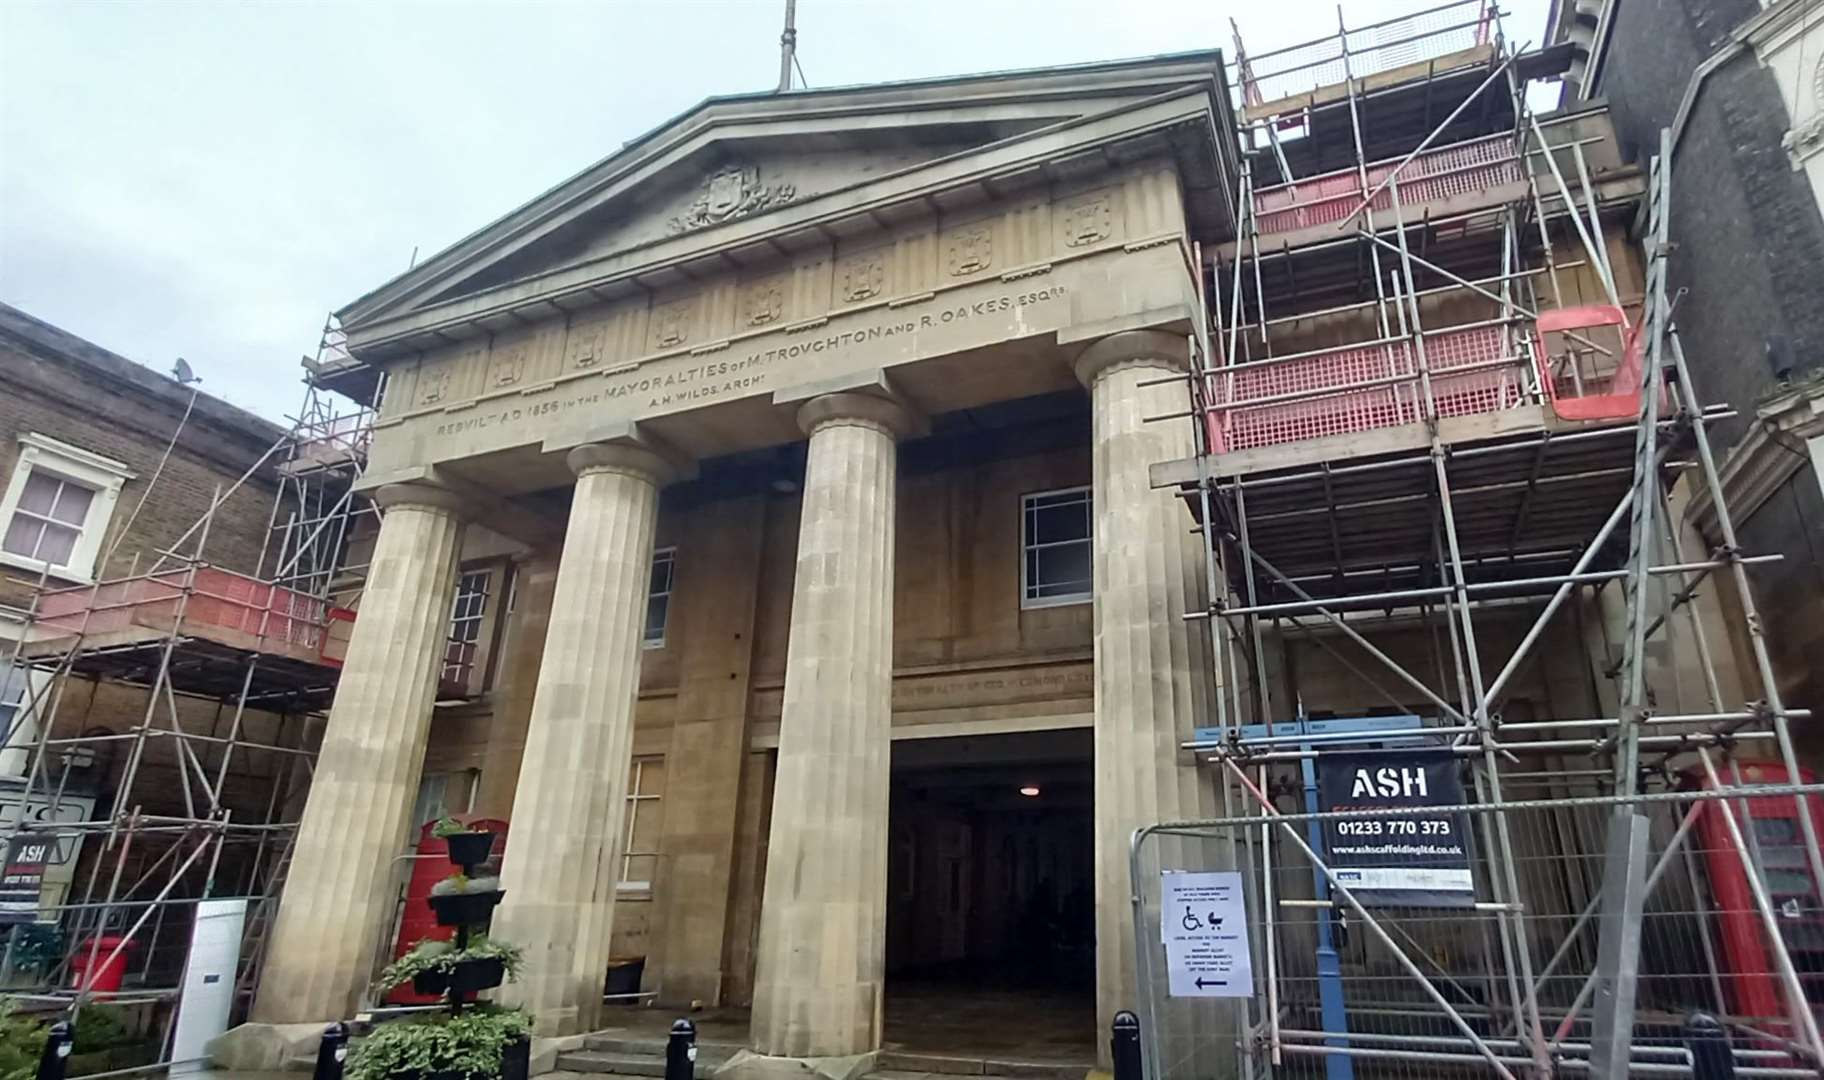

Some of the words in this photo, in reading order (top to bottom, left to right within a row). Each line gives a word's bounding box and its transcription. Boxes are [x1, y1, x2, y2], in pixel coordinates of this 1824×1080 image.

[604, 362, 728, 399] MAYORALTIES
[885, 323, 915, 337] AND
[1352, 767, 1428, 797] ASH
[1338, 821, 1382, 835] 01233
[1386, 821, 1416, 834] 770
[1420, 821, 1450, 834] 373
[16, 845, 46, 862] ASH
[1332, 844, 1462, 856] www.ashscaffoldingltd.co.uk
